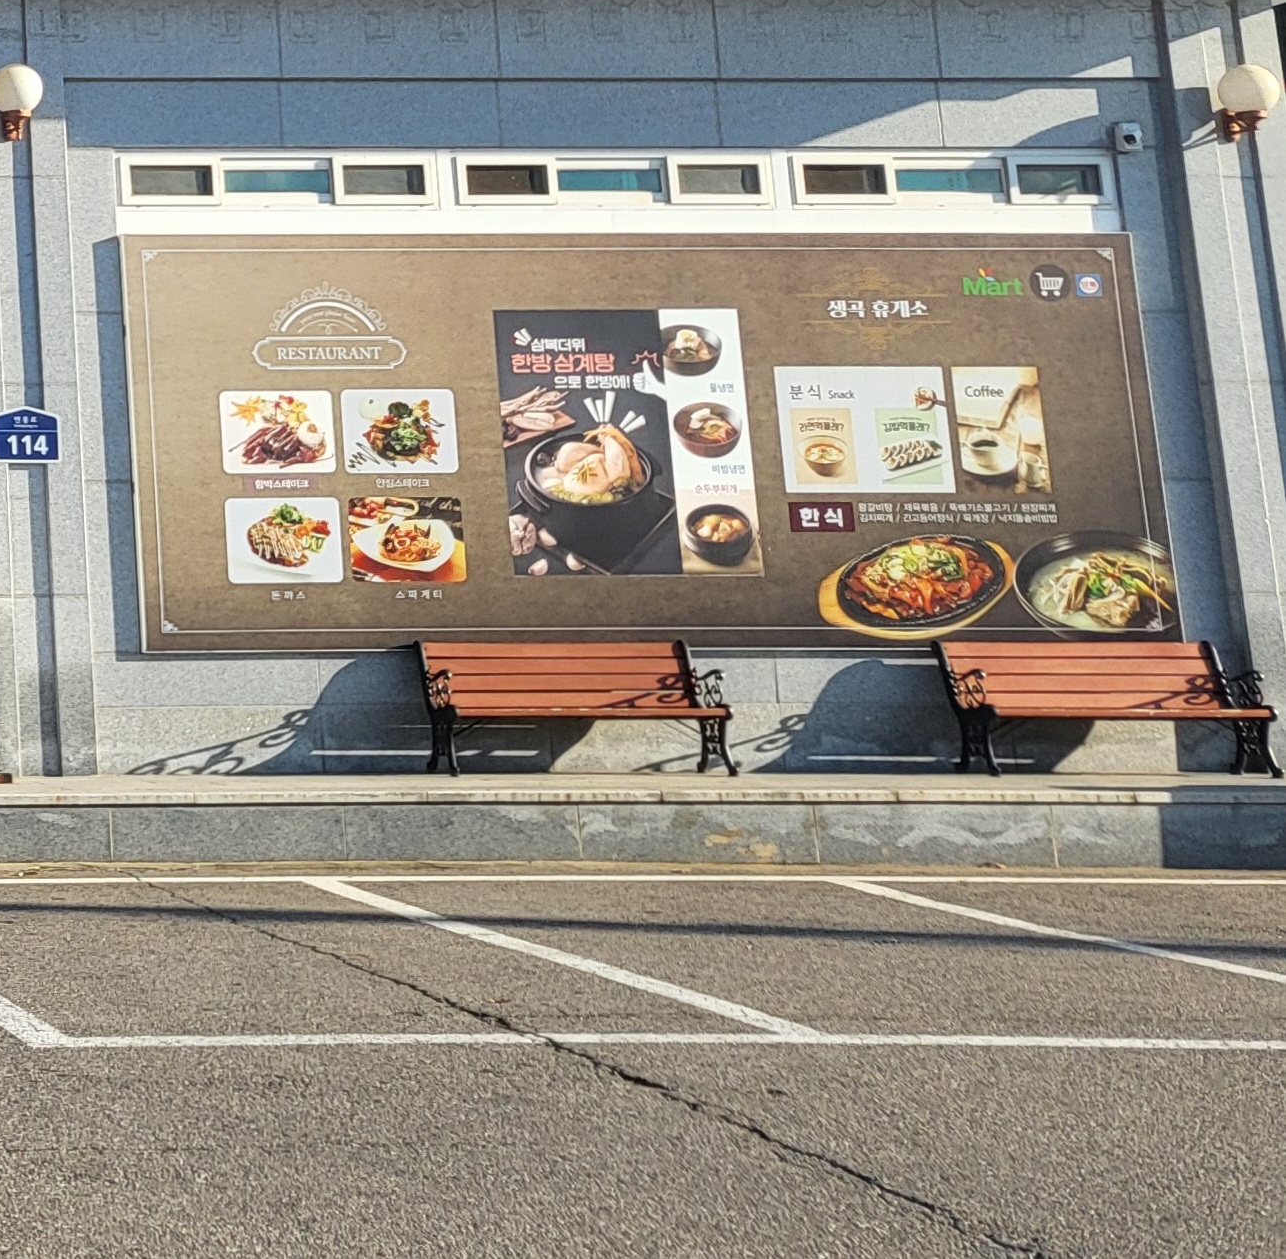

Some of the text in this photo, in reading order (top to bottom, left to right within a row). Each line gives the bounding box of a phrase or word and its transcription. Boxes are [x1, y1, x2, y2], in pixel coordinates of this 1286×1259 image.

[962, 276, 1023, 297] Mart
[826, 299, 930, 319] 생곡 휴게소
[276, 346, 383, 361] RESTAURANT
[530, 338, 586, 353] 삼복더위
[510, 352, 616, 374] 한방 삼계탕
[553, 374, 631, 390] 으로 한방에!
[789, 384, 856, 401] 분식 Snack
[963, 385, 1005, 399] Coffee
[6, 434, 49, 456] 114
[711, 464, 746, 475] 비빔냉면
[799, 507, 845, 528] 한식
